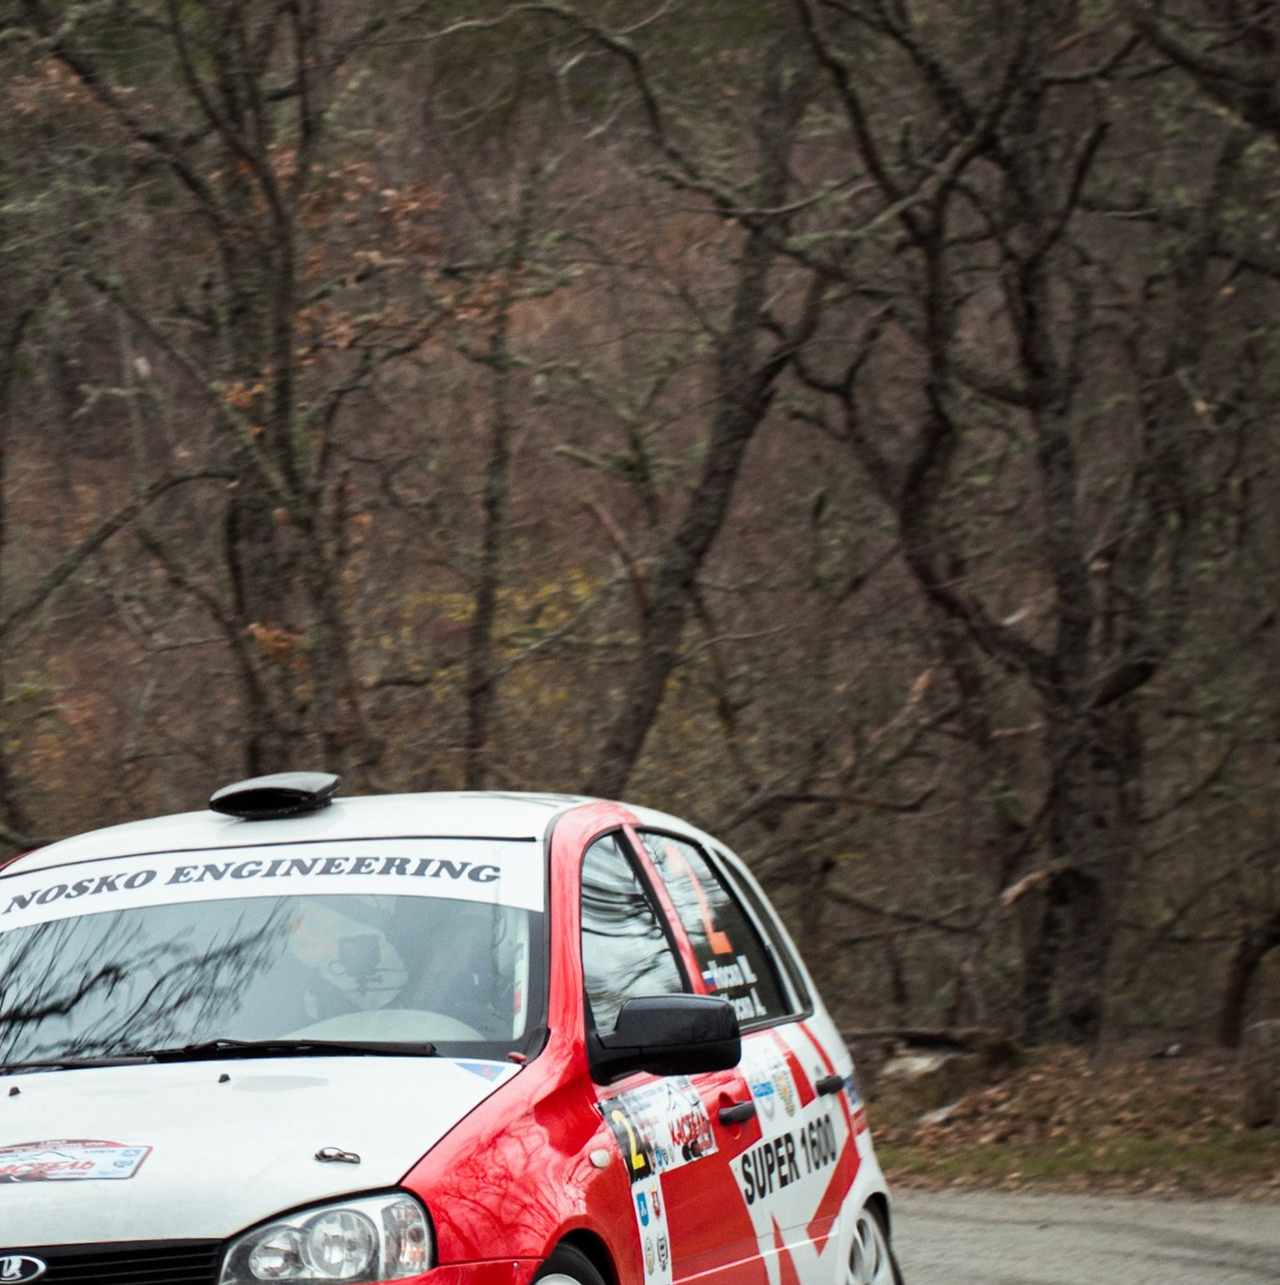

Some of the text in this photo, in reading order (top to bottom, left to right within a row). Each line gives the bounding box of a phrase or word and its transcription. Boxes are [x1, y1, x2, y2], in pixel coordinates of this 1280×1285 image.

[1, 856, 503, 915] NOSKO ENGINEERING
[612, 1109, 646, 1170] 2
[741, 1113, 838, 1205] SUPER 1600
